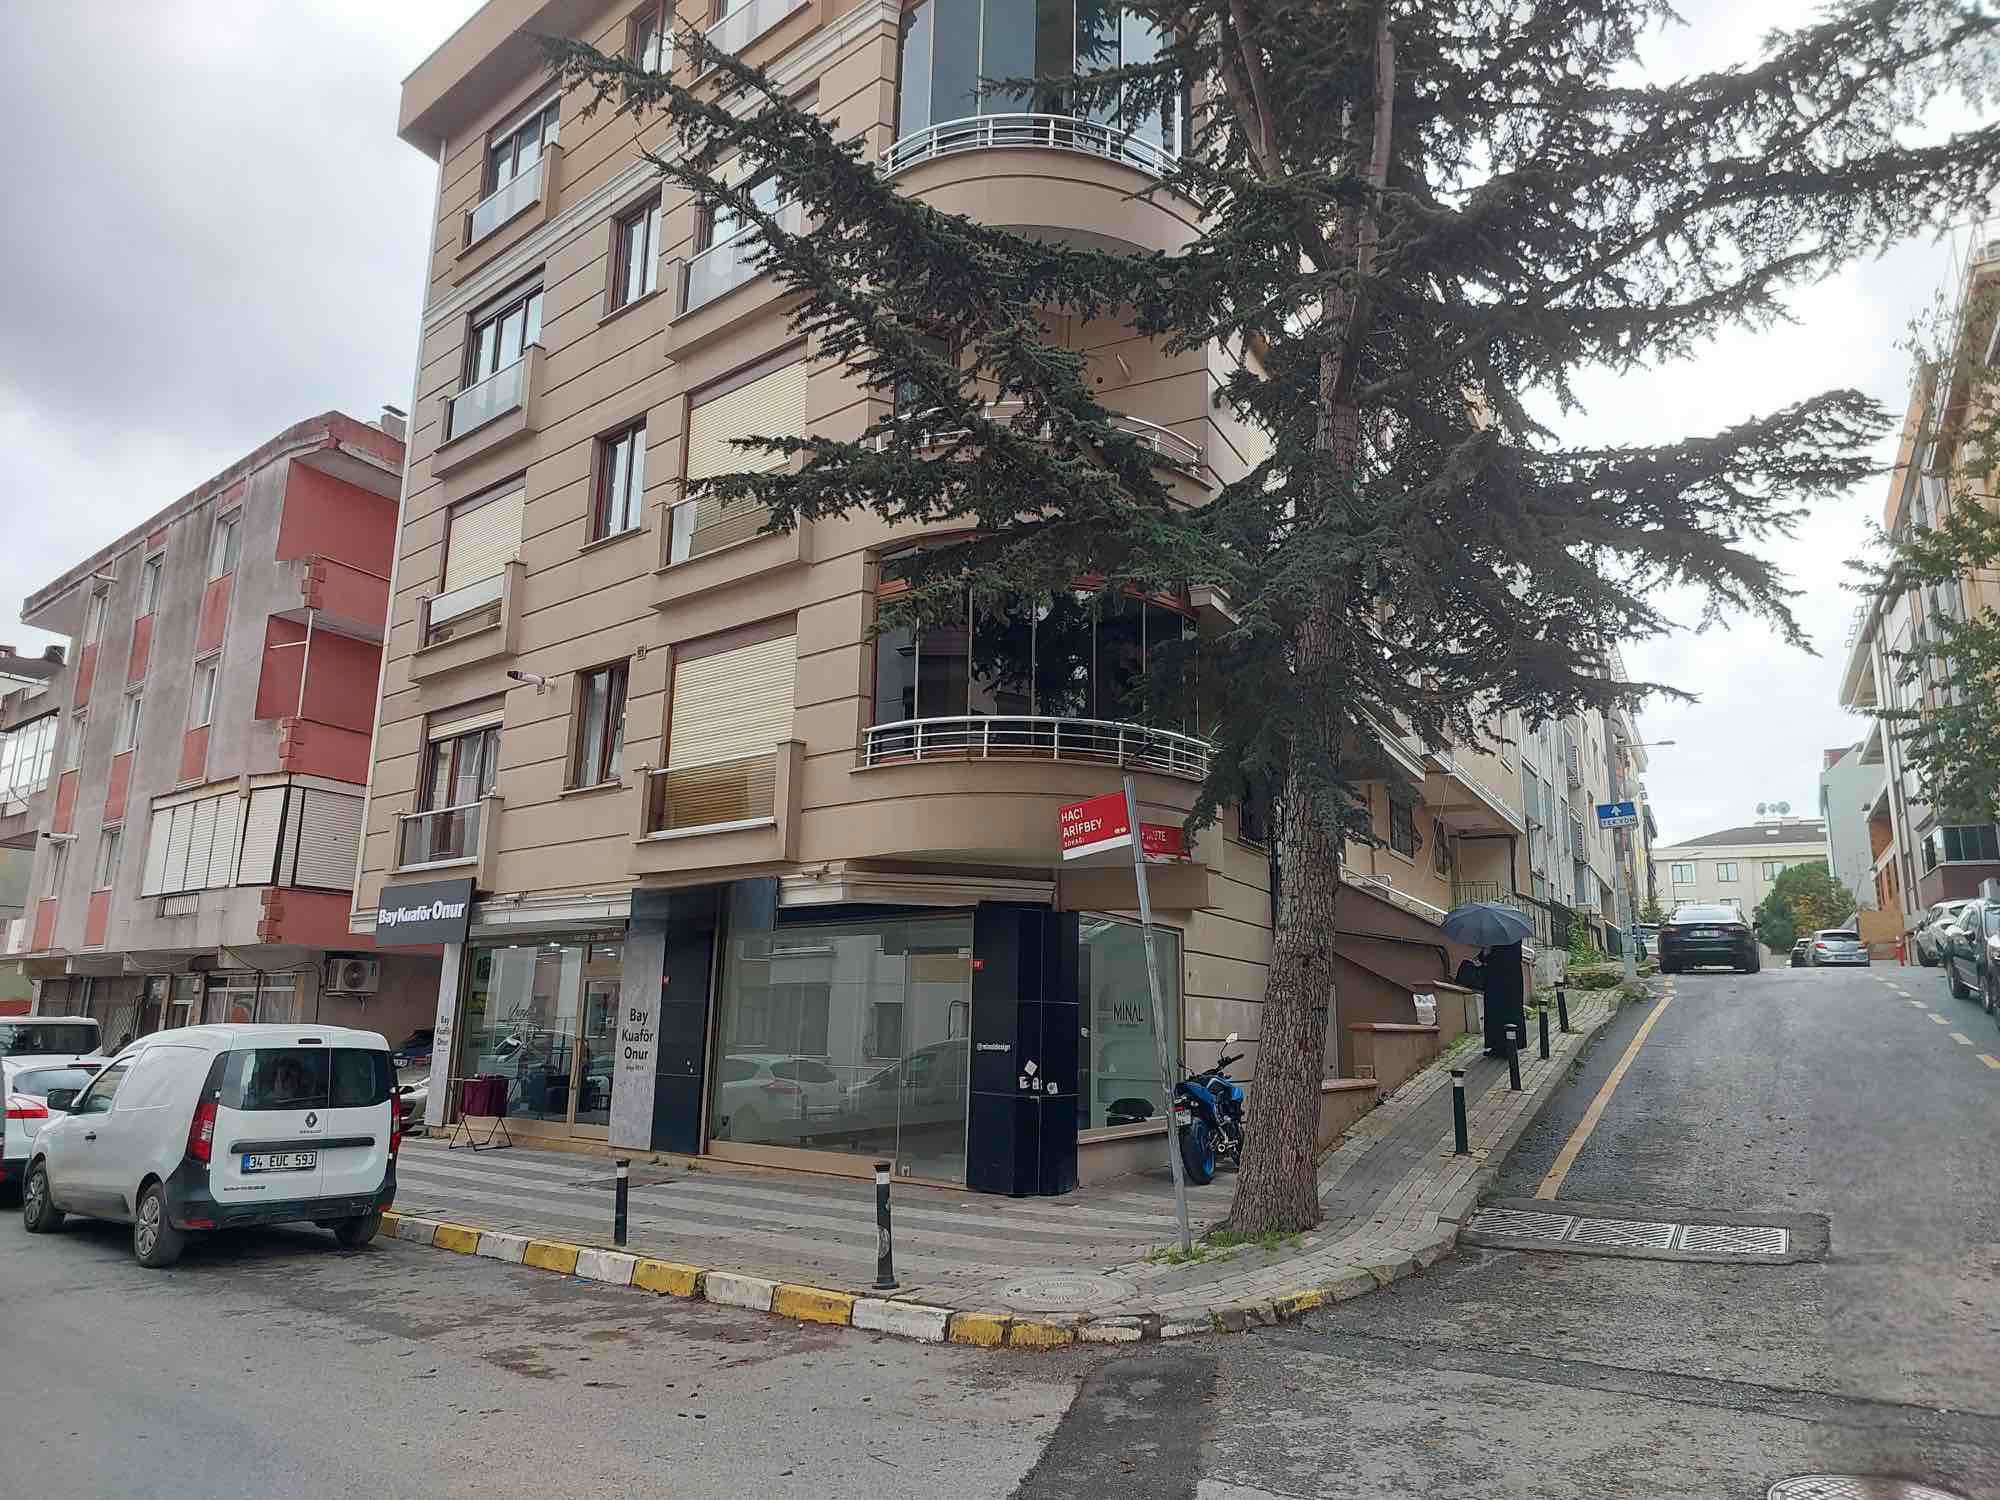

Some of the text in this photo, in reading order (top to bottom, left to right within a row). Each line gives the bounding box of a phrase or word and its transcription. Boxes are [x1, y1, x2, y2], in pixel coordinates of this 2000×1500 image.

[1061, 808, 1083, 823] HACI
[1063, 818, 1103, 838] ARİFBEY
[629, 1008, 649, 1026] Bay
[621, 1028, 655, 1043] Kuaför
[624, 1046, 649, 1060] Onur
[250, 1153, 314, 1168] 34 EUC 593
